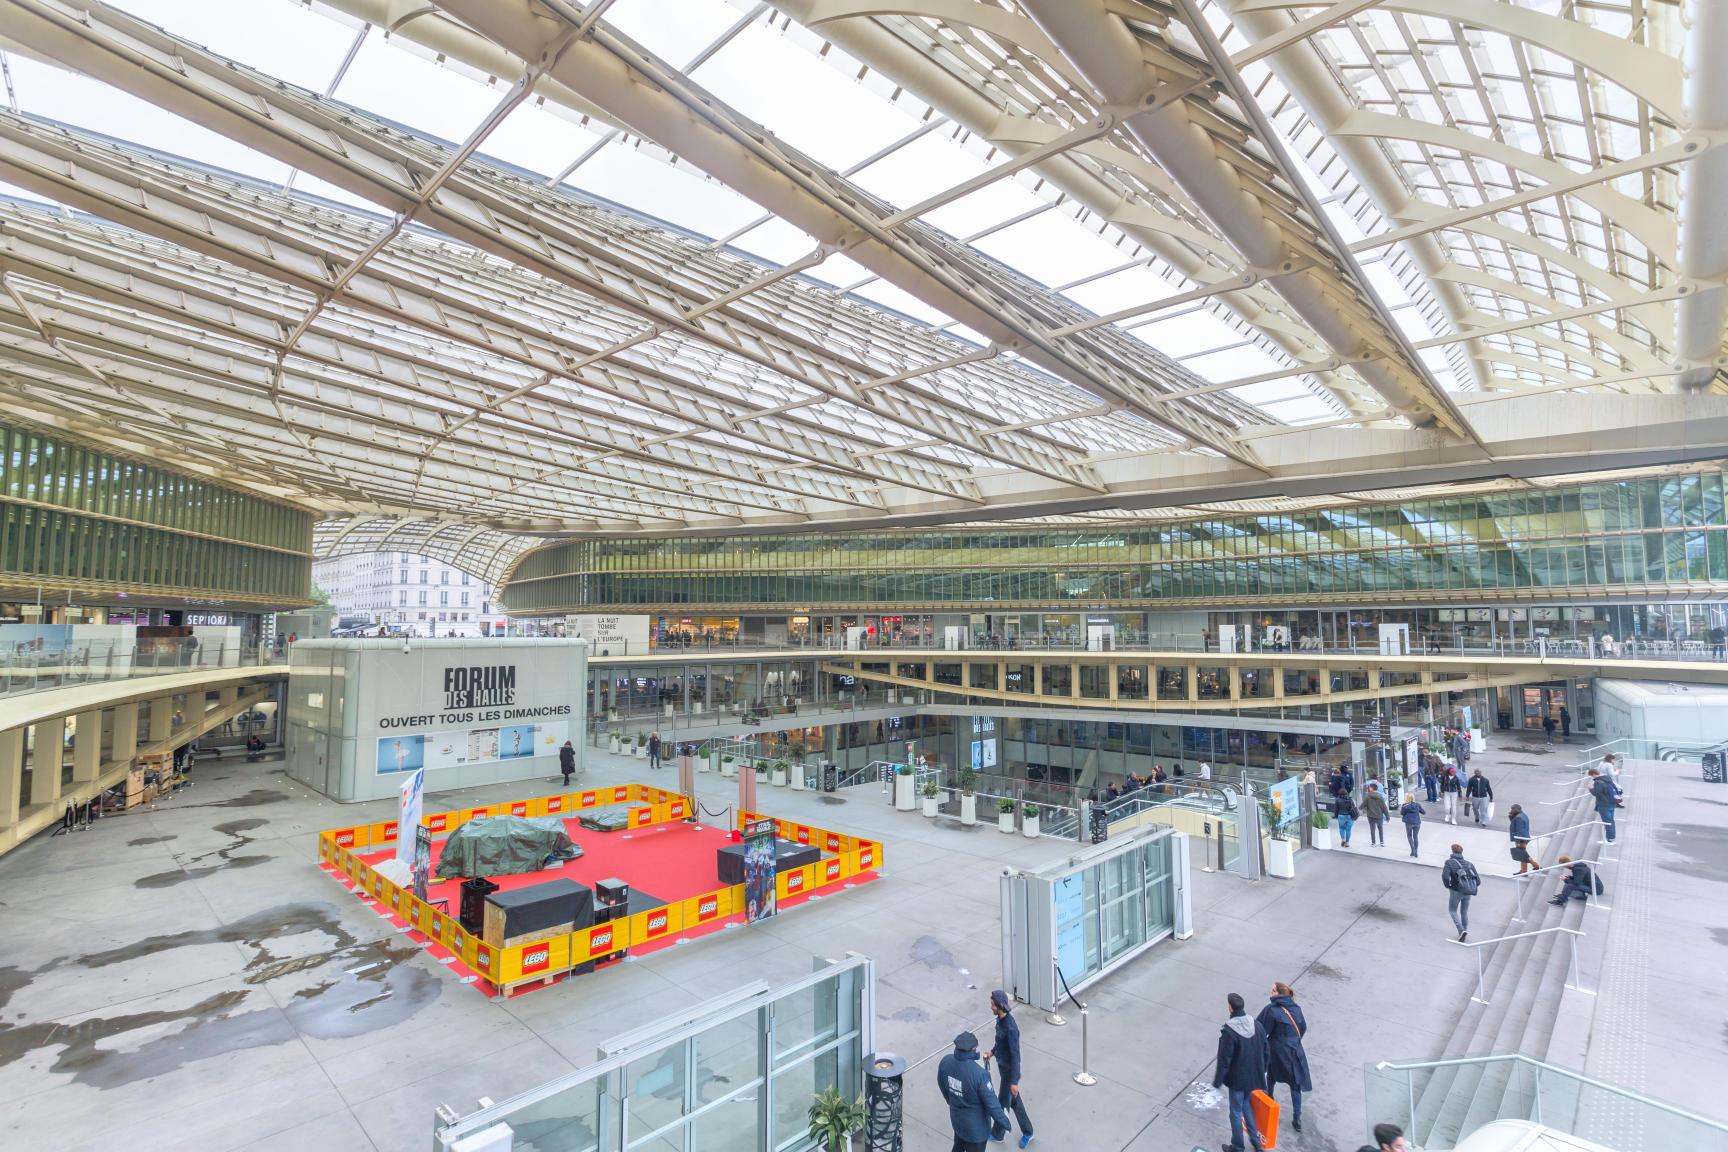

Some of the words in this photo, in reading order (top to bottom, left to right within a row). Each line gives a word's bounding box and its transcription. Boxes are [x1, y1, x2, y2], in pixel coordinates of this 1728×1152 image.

[444, 665, 516, 692] FORUM
[444, 690, 468, 709] DES
[472, 687, 516, 707] HALLES
[379, 714, 436, 729] OUVERT
[438, 711, 474, 724] TOUS
[478, 709, 501, 722] LES
[503, 704, 571, 719] DIMANCHES
[431, 819, 446, 828] LEGO
[861, 854, 873, 865] LEGO
[826, 863, 840, 875] LEGO
[788, 876, 803, 887] LEGO
[699, 901, 718, 914] LEGO
[648, 916, 667, 931] LEGO
[592, 932, 612, 947] LEGO
[478, 952, 490, 966] LEGO
[523, 950, 548, 967] LEGO
